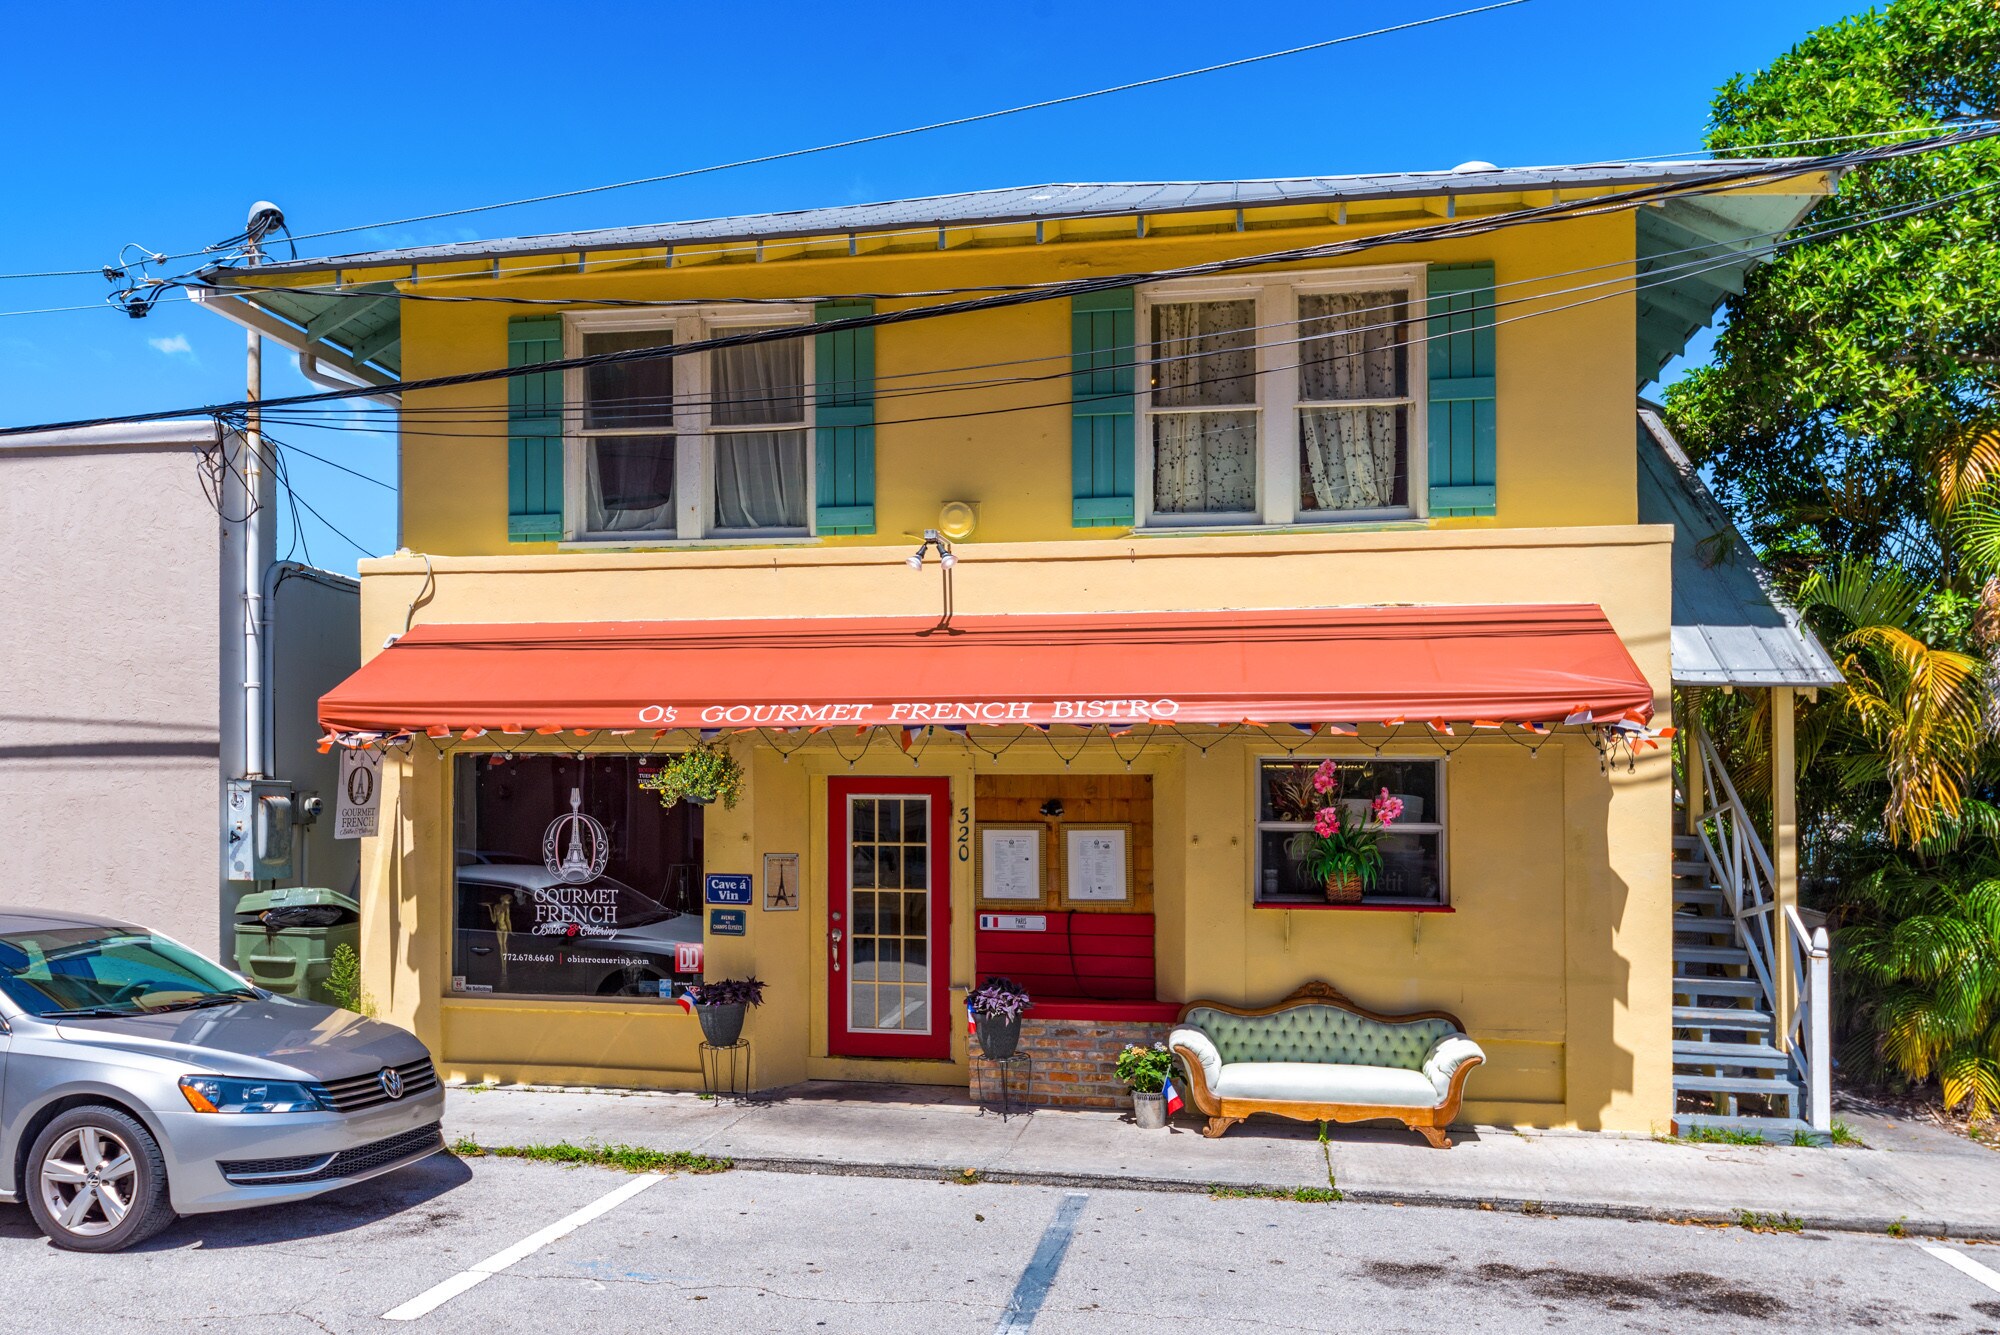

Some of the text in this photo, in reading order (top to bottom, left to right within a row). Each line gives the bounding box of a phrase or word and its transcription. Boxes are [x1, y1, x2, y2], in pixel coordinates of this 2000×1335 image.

[638, 699, 1179, 722] O's GOURMET FRENCH BISTRO
[342, 808, 375, 817] GOURMET
[341, 817, 374, 828] FRENCH
[957, 807, 969, 862] 320
[711, 879, 737, 889] Cave
[534, 888, 619, 904] GOURMET
[718, 890, 739, 900] Vin
[535, 905, 618, 923] FRENCH
[531, 923, 567, 936] Bistro
[579, 924, 619, 941] Catering
[502, 953, 650, 967] 772.678.6640 obistrocatering.com
